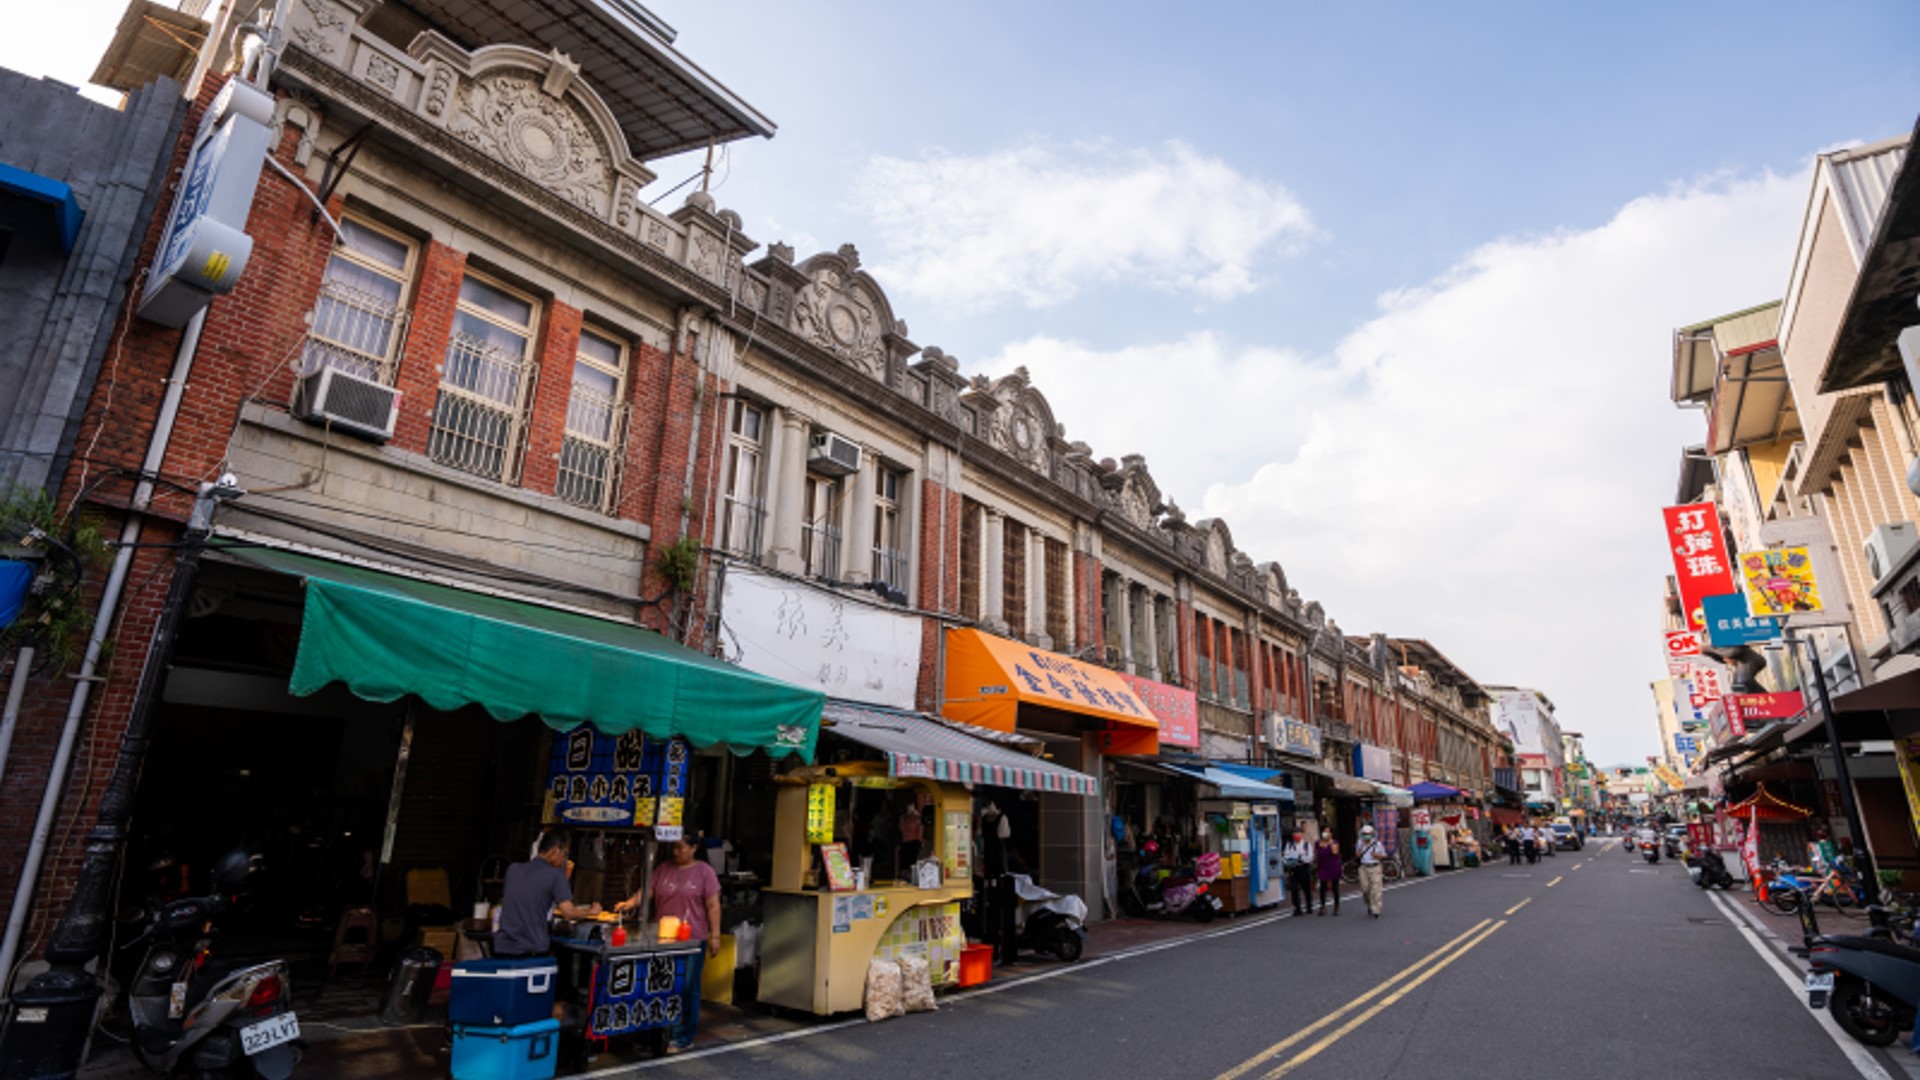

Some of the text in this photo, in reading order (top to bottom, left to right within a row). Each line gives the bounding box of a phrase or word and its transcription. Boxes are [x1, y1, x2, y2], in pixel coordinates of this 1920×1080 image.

[1677, 509, 1723, 577] 打彈珠
[1667, 635, 1700, 652] OK
